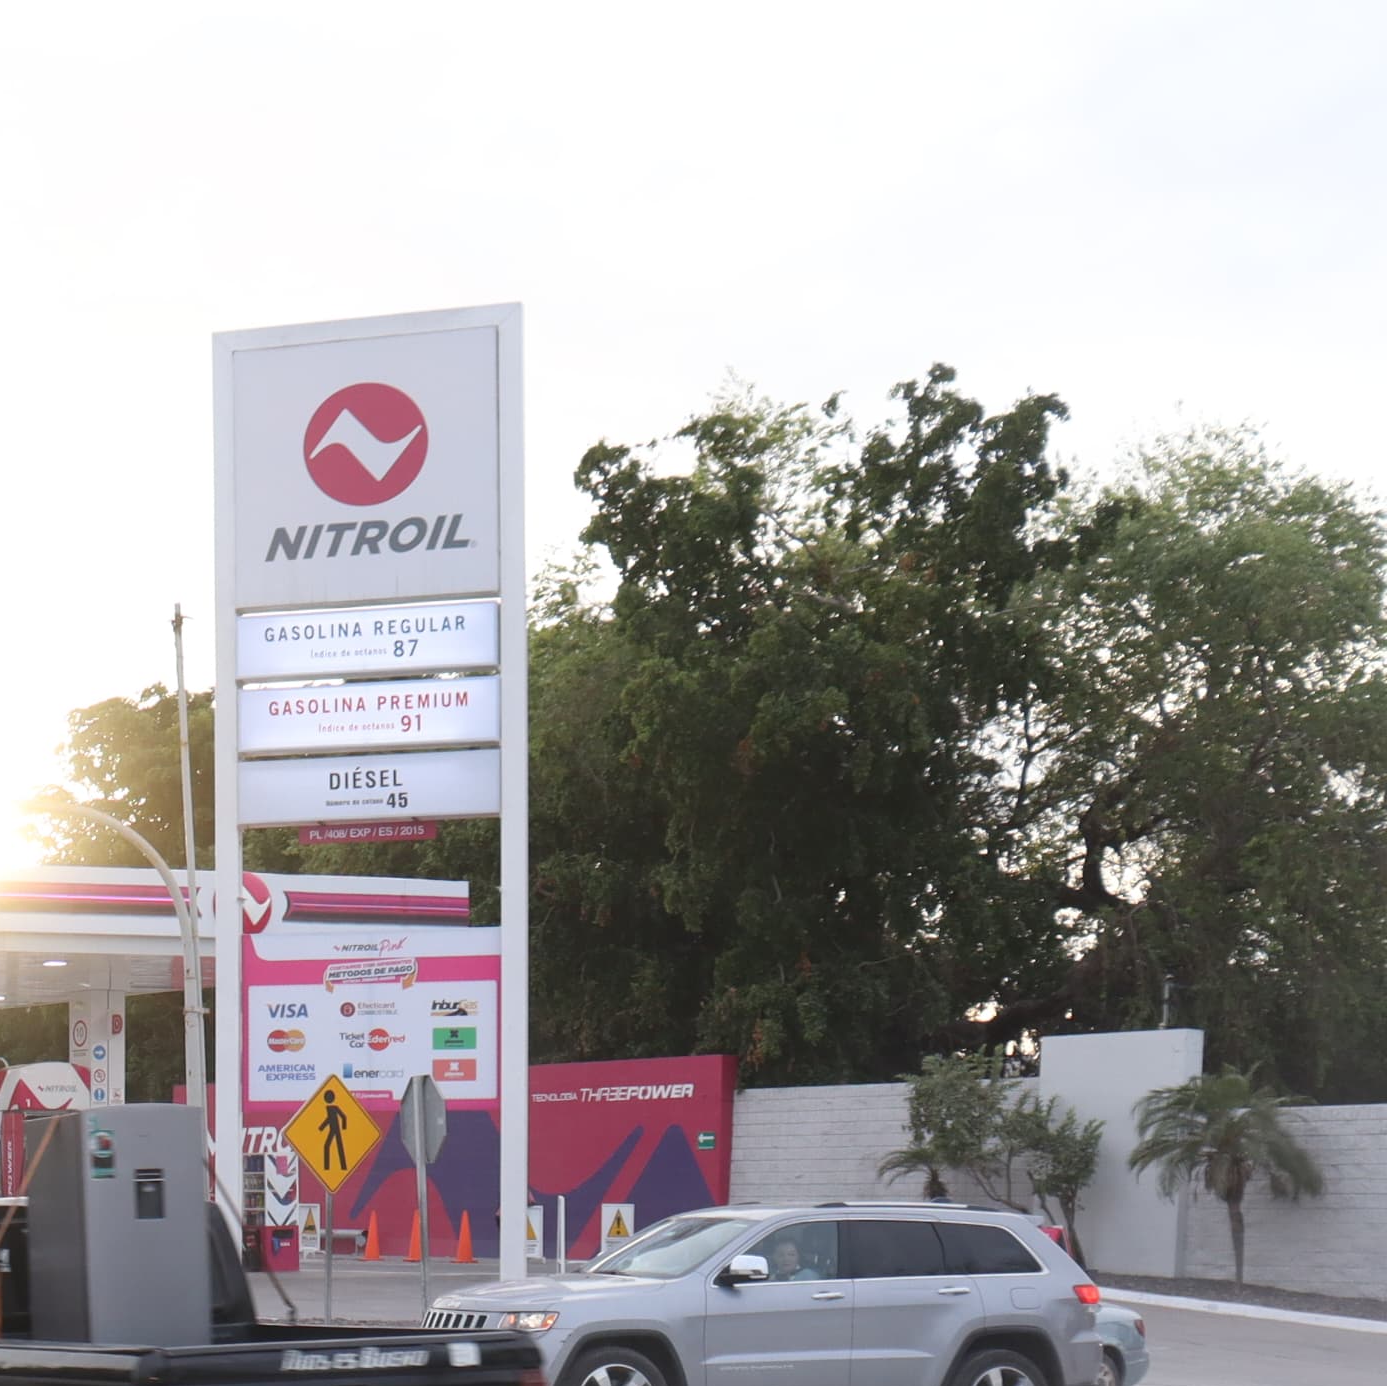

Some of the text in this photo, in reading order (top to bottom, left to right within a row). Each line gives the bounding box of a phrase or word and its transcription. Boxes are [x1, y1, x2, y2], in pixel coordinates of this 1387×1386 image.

[265, 513, 471, 562] NITROIL
[264, 615, 466, 642] GASOLINA REGULAR
[341, 648, 350, 657] de
[354, 647, 387, 657] octanos
[393, 639, 418, 657] 87
[268, 691, 469, 716] GASOLINA PREMIUM
[348, 723, 358, 732] de
[362, 721, 395, 731] octanos
[400, 714, 422, 732] 91
[329, 767, 403, 790] DIÉSEL
[386, 792, 408, 808] 45
[309, 829, 322, 840] PL
[349, 827, 371, 838] EXP
[378, 826, 393, 837] ES
[400, 825, 425, 836] 2015
[341, 936, 408, 957] NITROIL Pink
[328, 965, 413, 978] METODOS DE PAGO
[267, 1003, 309, 1018] VISA
[339, 1032, 365, 1041] Ticket
[349, 1040, 365, 1049] Car
[257, 1064, 315, 1073] AMERICAN
[266, 1073, 316, 1082] EXPRESS
